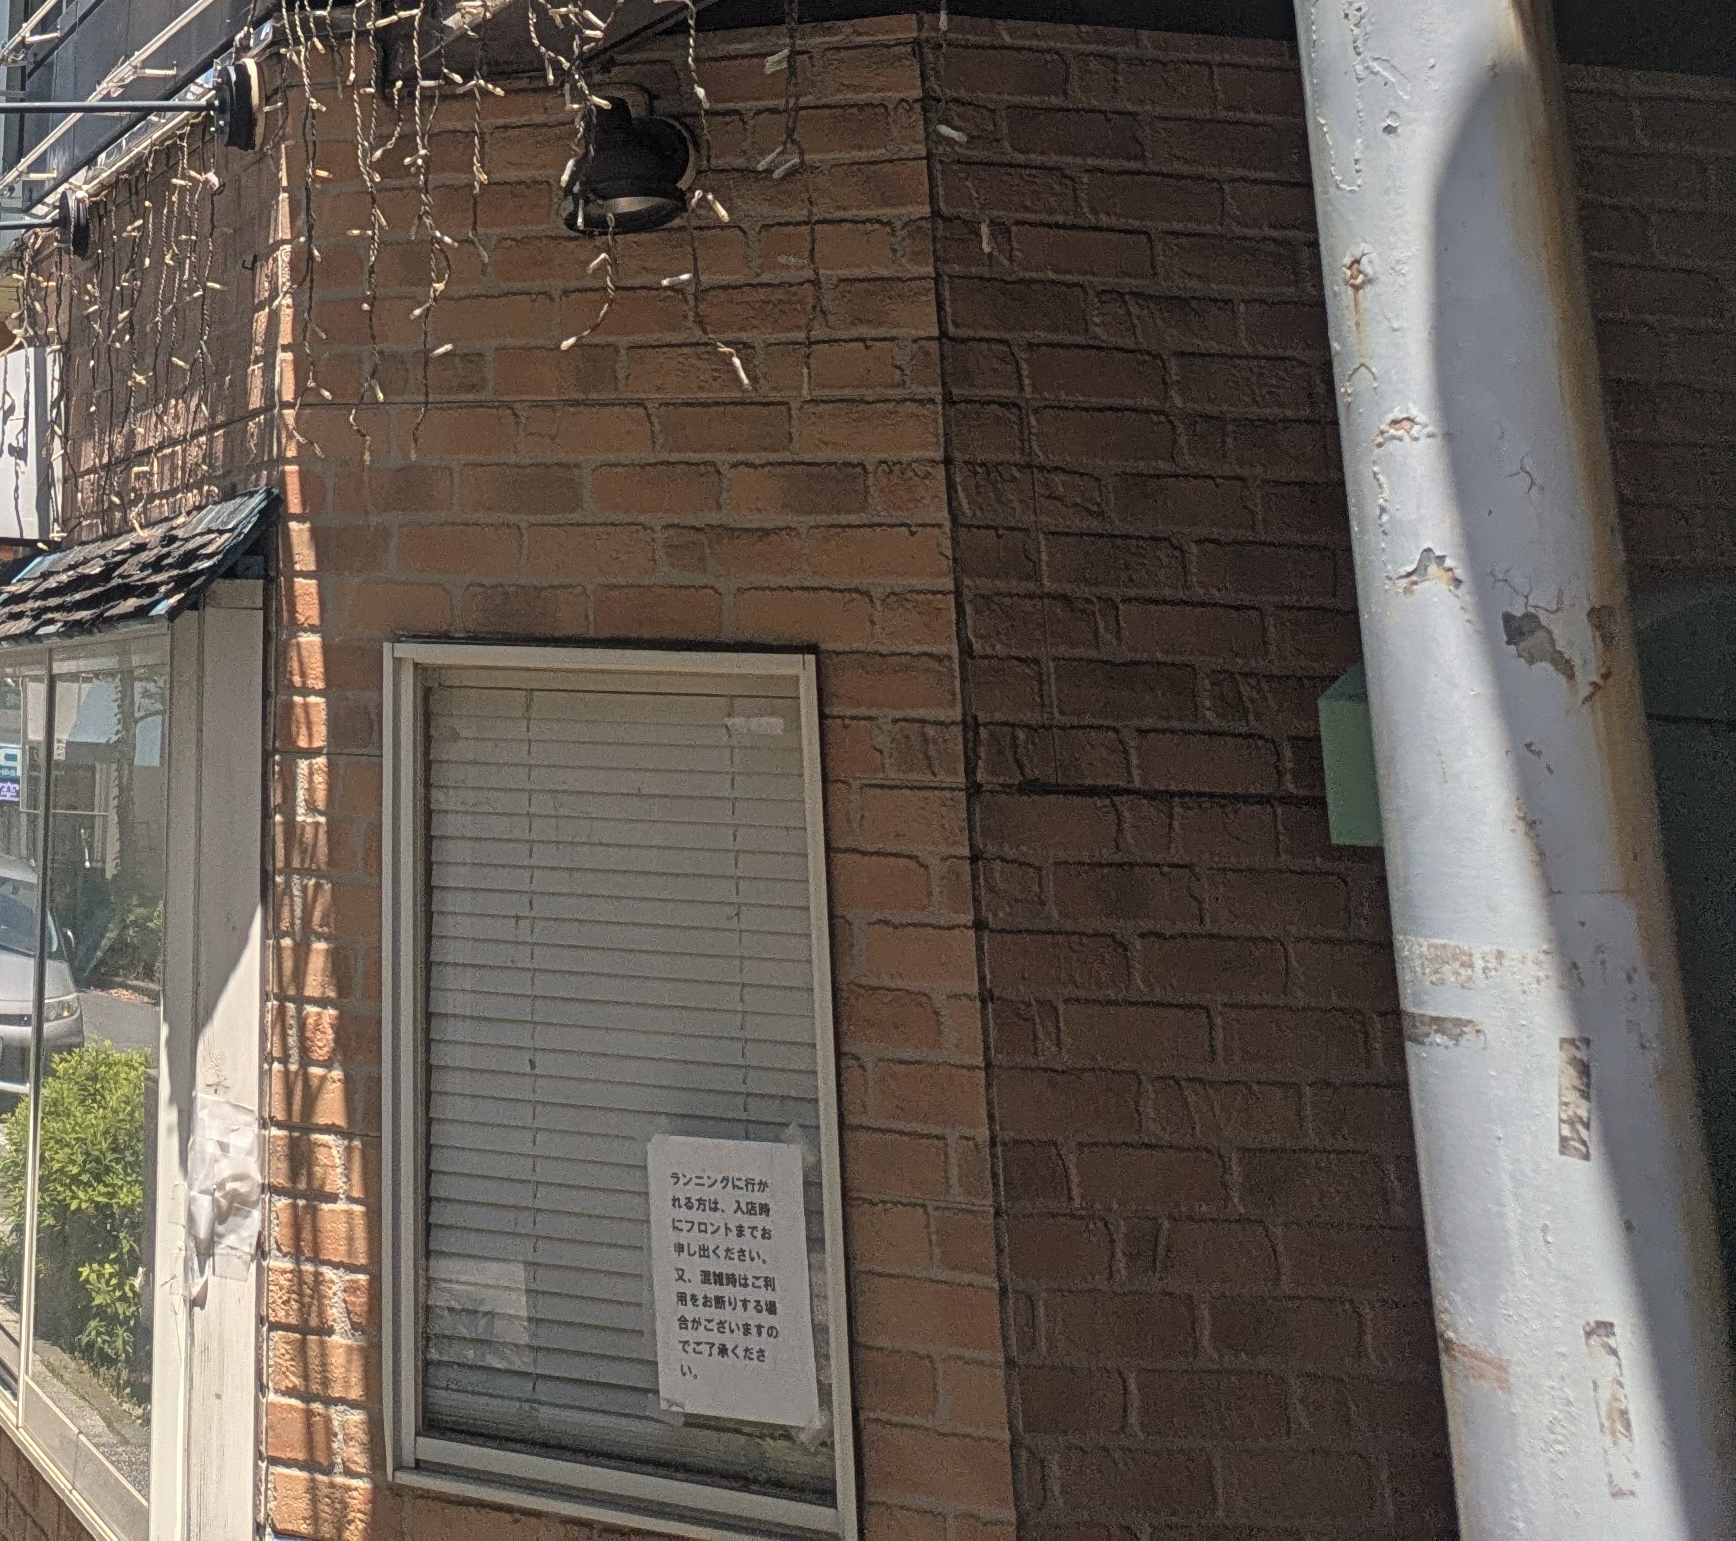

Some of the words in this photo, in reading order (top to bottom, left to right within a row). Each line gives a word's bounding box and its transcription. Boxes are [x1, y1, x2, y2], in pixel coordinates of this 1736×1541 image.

[670, 1172, 769, 1193] ランニングに行か
[671, 1195, 771, 1217] れる方は、入店時
[672, 1217, 772, 1240] にフロントまでお
[673, 1241, 767, 1264] 申し出ください。
[674, 1267, 776, 1292] 又、混雑時はご利
[676, 1291, 778, 1316] 用をお断りする場
[677, 1315, 779, 1339] 合がございますの
[678, 1339, 766, 1362] でご了承くださ
[680, 1363, 698, 1380] い。
